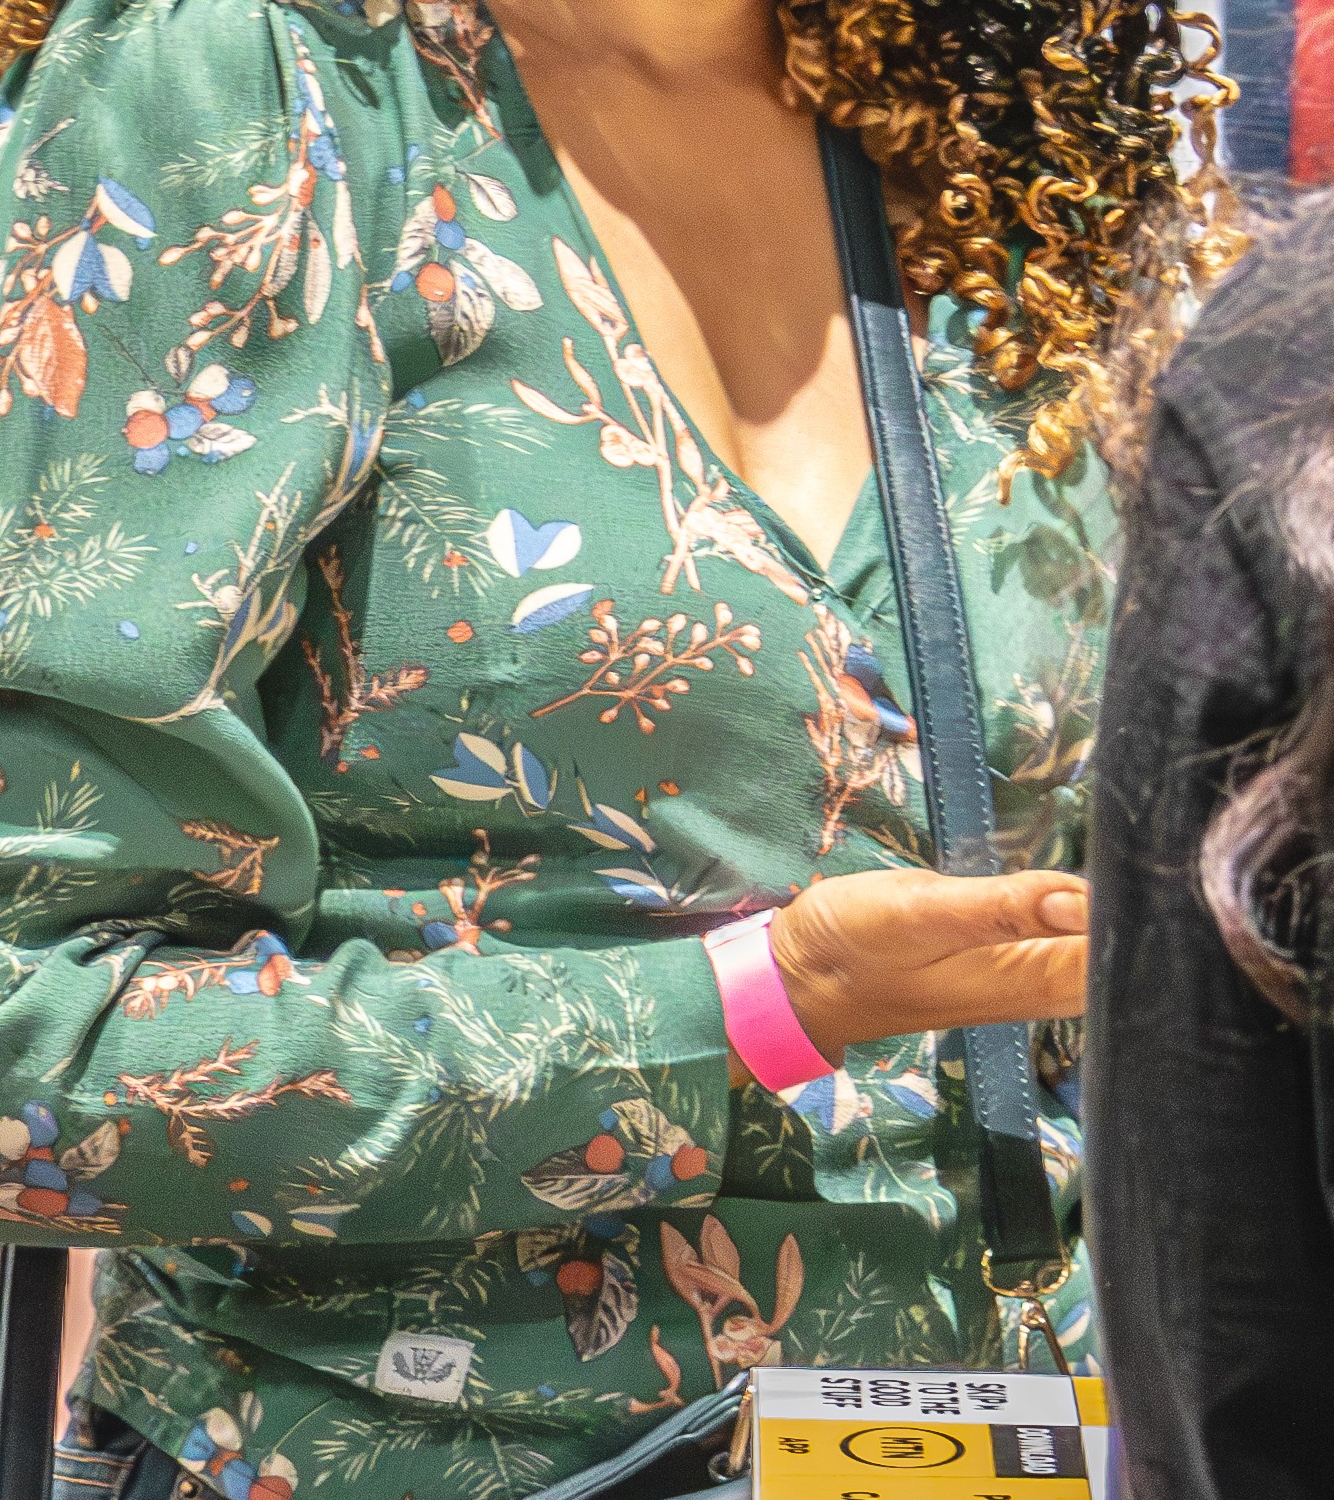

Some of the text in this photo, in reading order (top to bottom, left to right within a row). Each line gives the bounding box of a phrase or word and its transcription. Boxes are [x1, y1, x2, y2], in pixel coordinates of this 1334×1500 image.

[820, 1377, 863, 1409] STUFF
[868, 1379, 912, 1407] GOOD
[917, 1381, 961, 1415] TO THE
[965, 1382, 1008, 1404] SKIP
[778, 1436, 811, 1455] APP
[880, 1436, 925, 1459] MTN
[1016, 1427, 1058, 1474] DOWNLOAD
